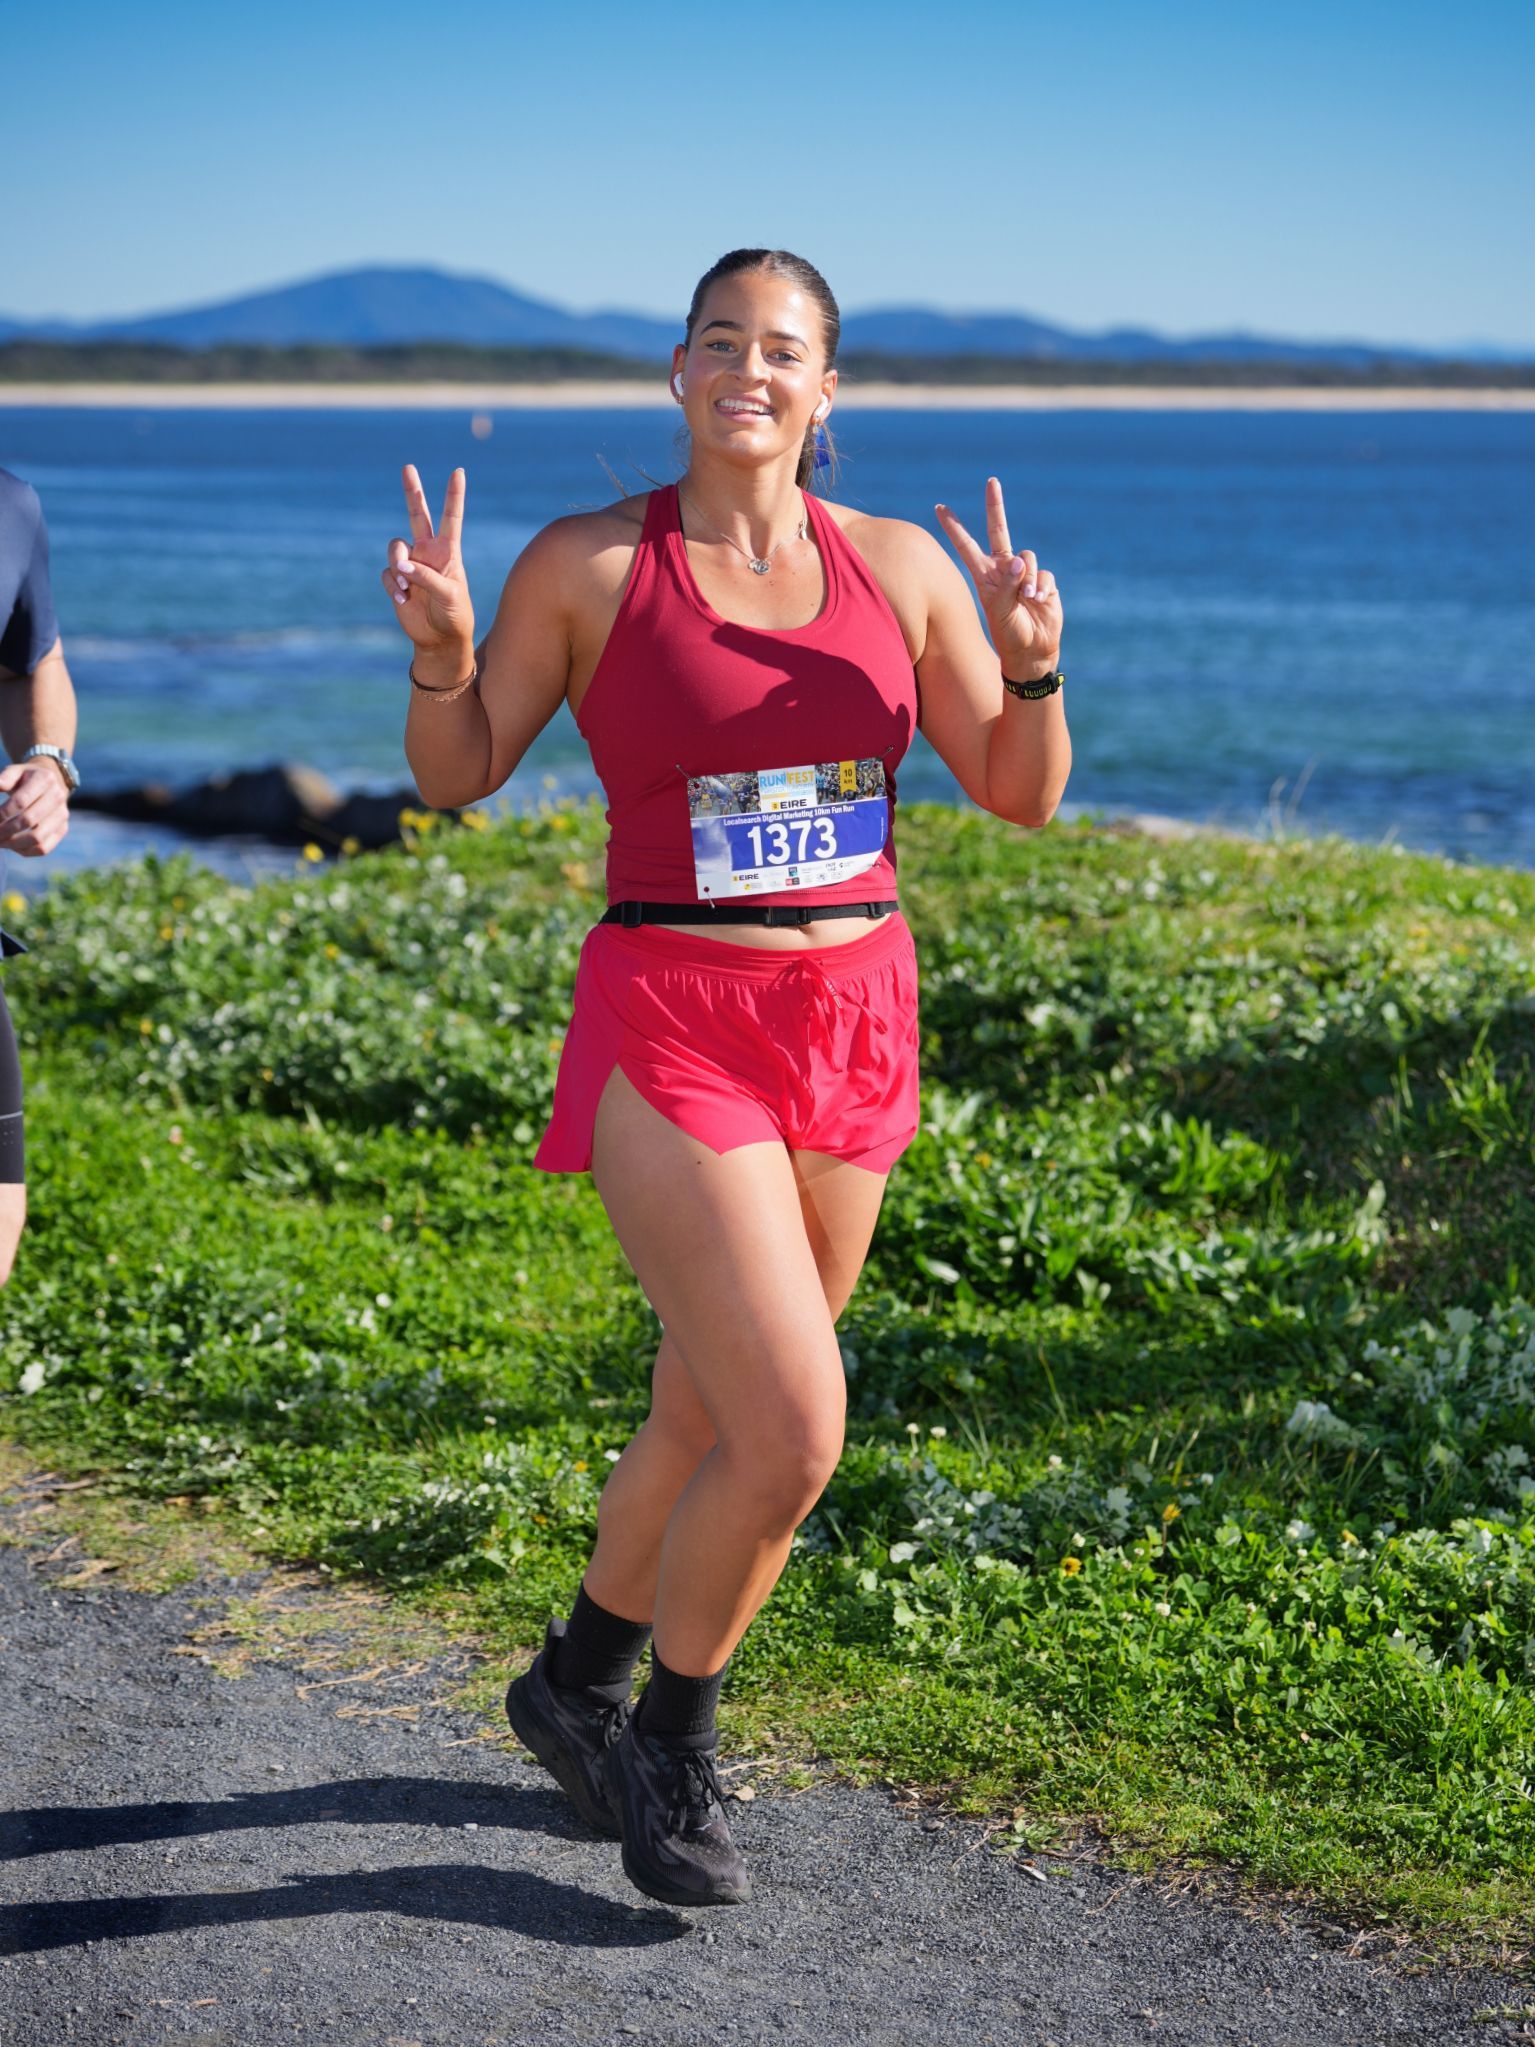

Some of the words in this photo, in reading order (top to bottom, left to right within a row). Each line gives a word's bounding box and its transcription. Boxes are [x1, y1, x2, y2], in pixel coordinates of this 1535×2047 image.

[844, 768, 853, 777] 10
[780, 799, 807, 809] EIRE
[723, 817, 761, 826] Localsearch
[762, 814, 783, 823] Digital
[784, 808, 814, 819] Marketing
[814, 807, 831, 815] 10km
[747, 817, 837, 867] 1373
[739, 873, 759, 881] EIRE
